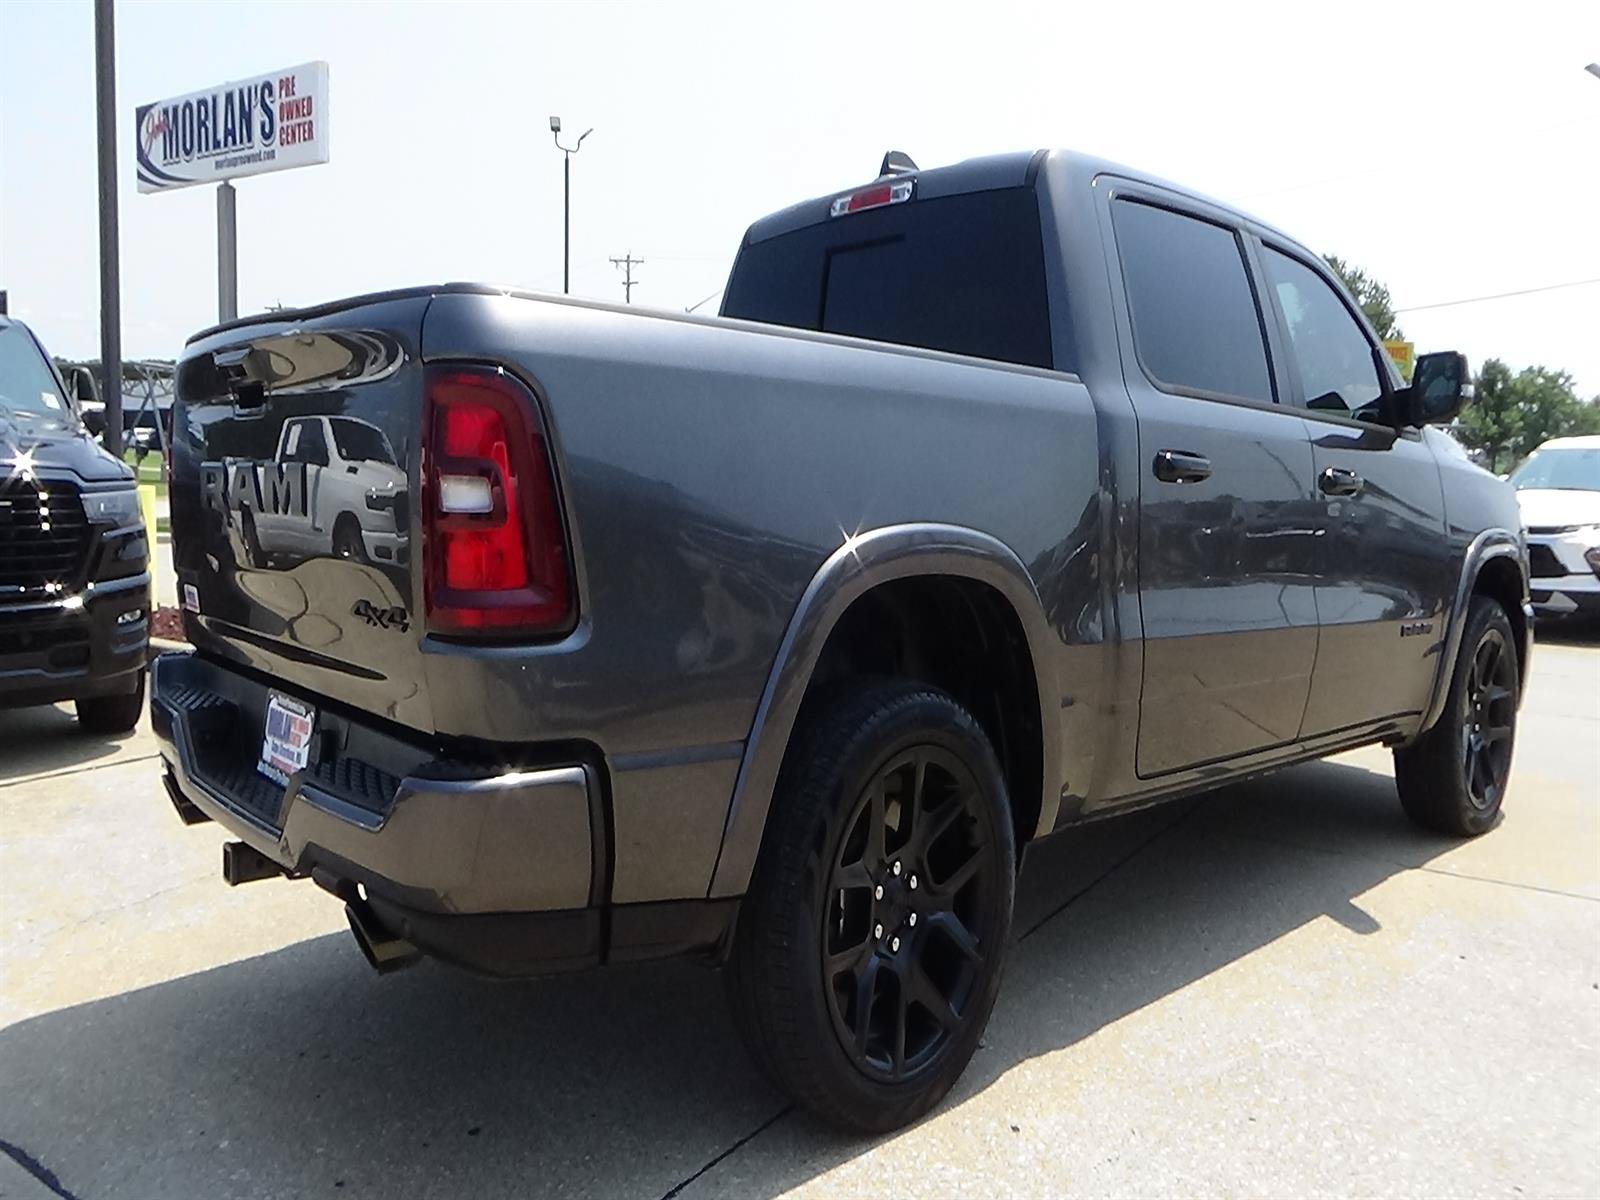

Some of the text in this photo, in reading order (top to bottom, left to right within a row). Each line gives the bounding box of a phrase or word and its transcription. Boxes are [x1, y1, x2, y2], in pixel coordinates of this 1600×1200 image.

[278, 75, 296, 99] PRE
[163, 80, 274, 160] MORLAN'S
[279, 96, 313, 121] OWNED
[279, 119, 314, 146] CENTER
[200, 460, 308, 517] RAM
